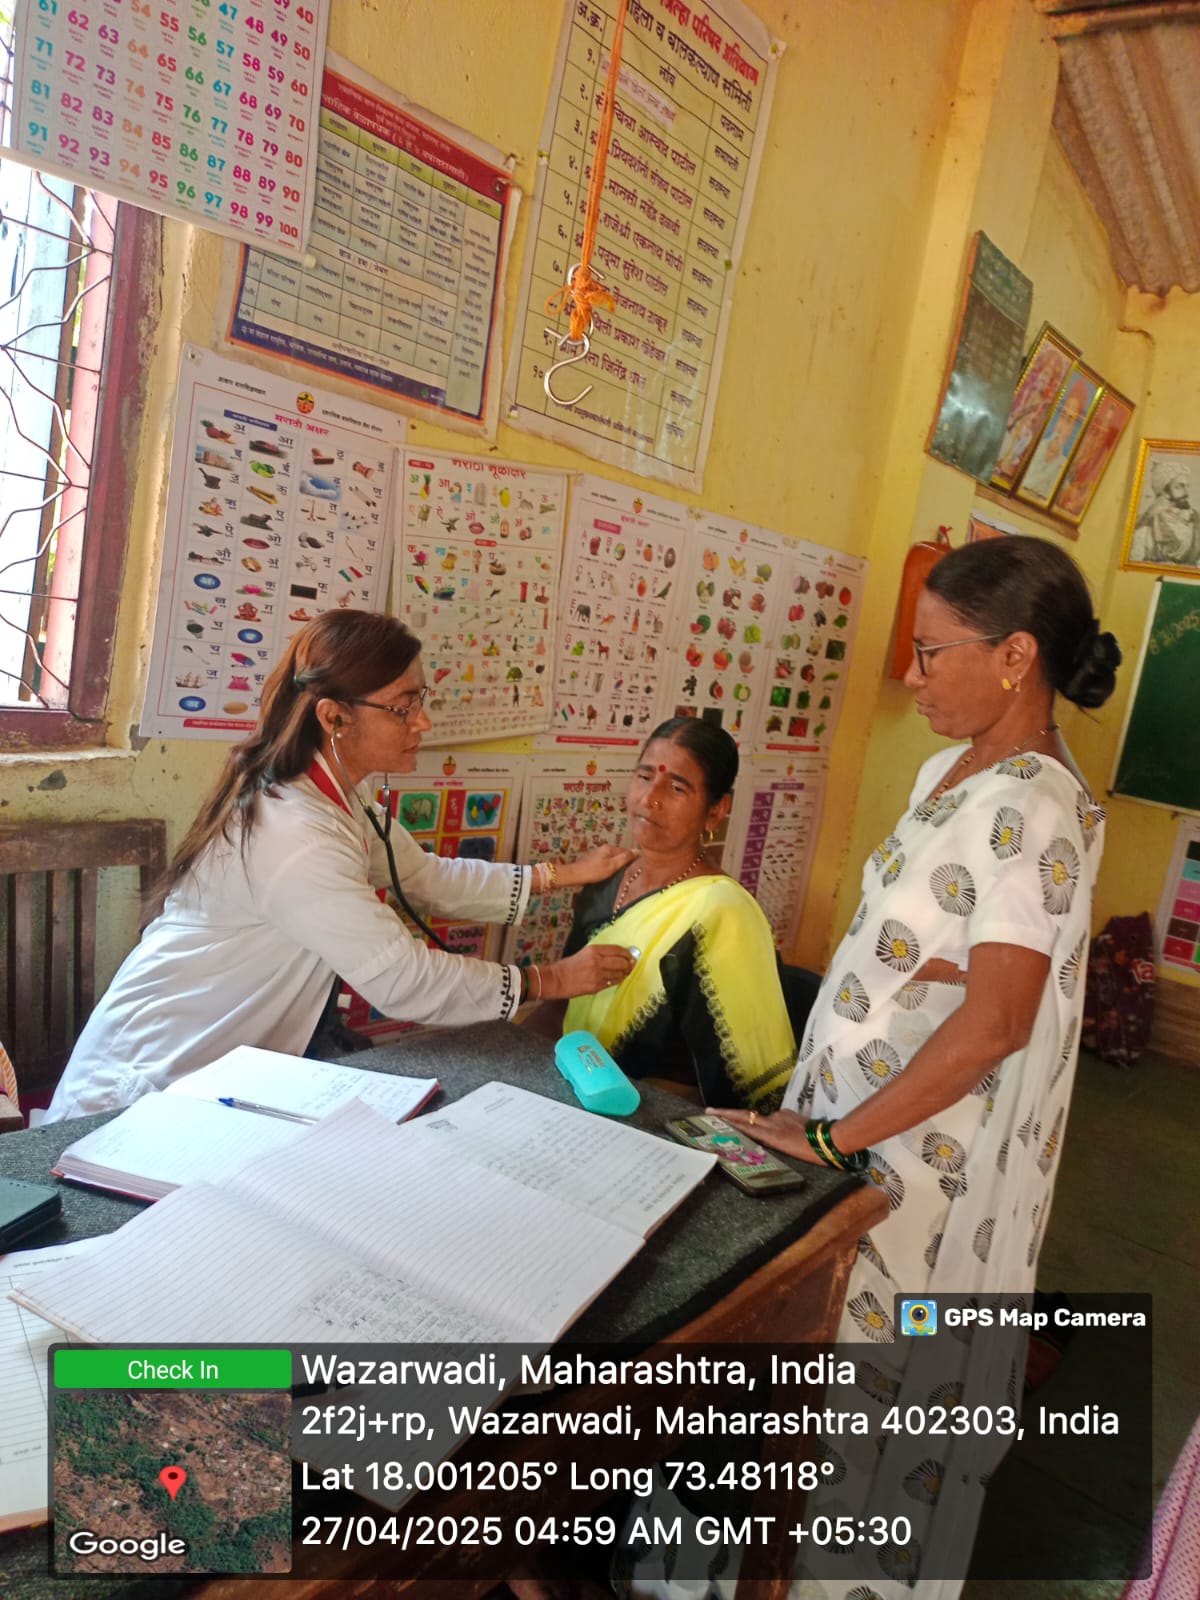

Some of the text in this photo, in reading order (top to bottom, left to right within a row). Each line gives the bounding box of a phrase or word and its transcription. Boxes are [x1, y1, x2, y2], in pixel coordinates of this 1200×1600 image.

[39, 0, 57, 16] 61
[68, 9, 89, 31] 62
[98, 24, 120, 45] 63
[127, 39, 148, 58] 64
[157, 53, 177, 72] 65
[185, 66, 204, 84] 66
[212, 80, 232, 96] 67
[239, 92, 258, 110] 68
[265, 104, 282, 120] 69
[289, 114, 305, 132] 70
[160, 12, 179, 32] 55
[188, 27, 207, 46] 56
[216, 39, 234, 58] 57
[242, 52, 262, 72] 58
[268, 65, 285, 83] 59
[291, 80, 308, 97] 60
[219, 2, 311, 61] 47 48 49 50
[297, 7, 313, 24] 40
[31, 80, 300, 203] 81 82 83 84 85 86 87 88 89 90
[35, 38, 303, 168] 71 72 73 74 75 76 77 78 79 80
[28, 122, 48, 141] 91
[58, 134, 80, 155] 92
[89, 147, 110, 167] 93
[120, 159, 140, 177] 94
[149, 170, 168, 189] 95
[177, 181, 196, 199] 96
[205, 191, 223, 208] 97
[230, 201, 249, 219] 98
[256, 211, 274, 228] 99
[279, 222, 299, 238] 100
